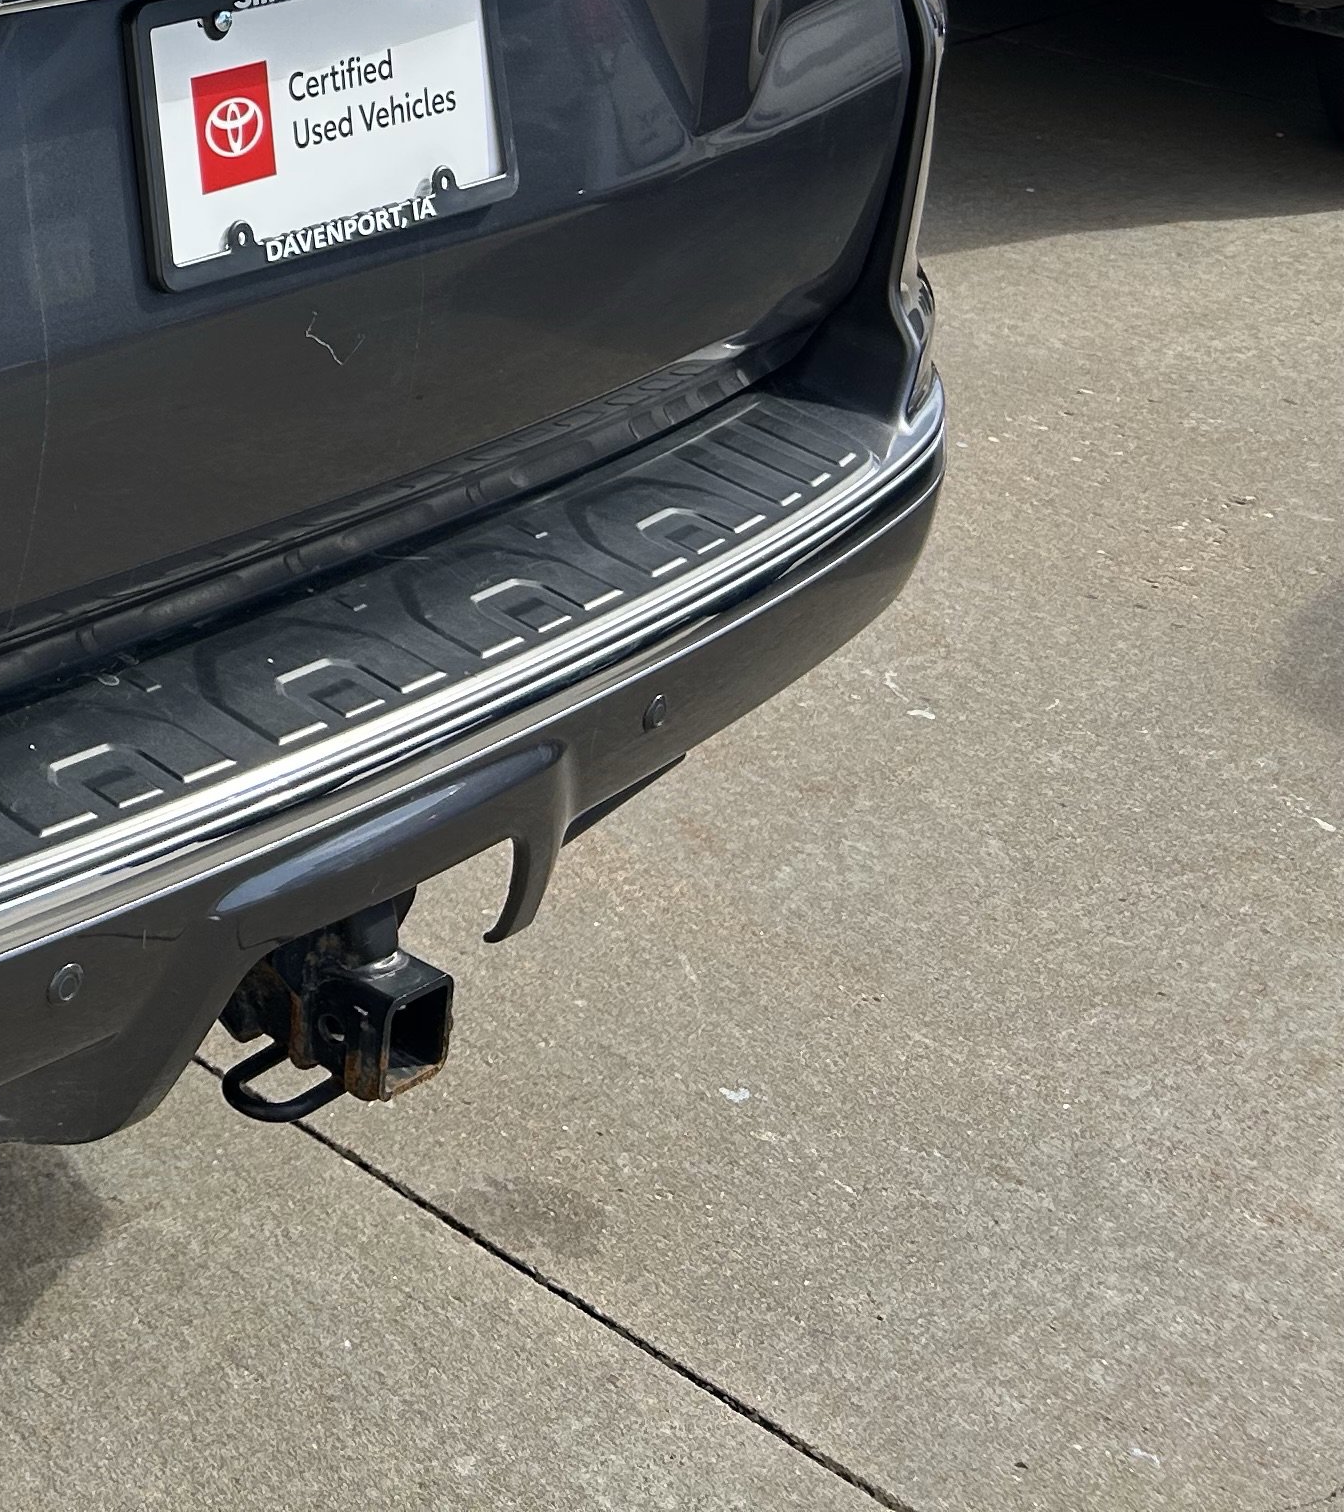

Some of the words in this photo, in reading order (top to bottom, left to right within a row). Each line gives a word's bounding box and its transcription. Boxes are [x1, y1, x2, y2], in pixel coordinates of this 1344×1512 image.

[288, 48, 394, 101] Certified
[292, 105, 353, 148] Used
[358, 87, 457, 132] Vehicles
[265, 201, 411, 263] DAVENPORT,
[412, 193, 437, 221] IA
